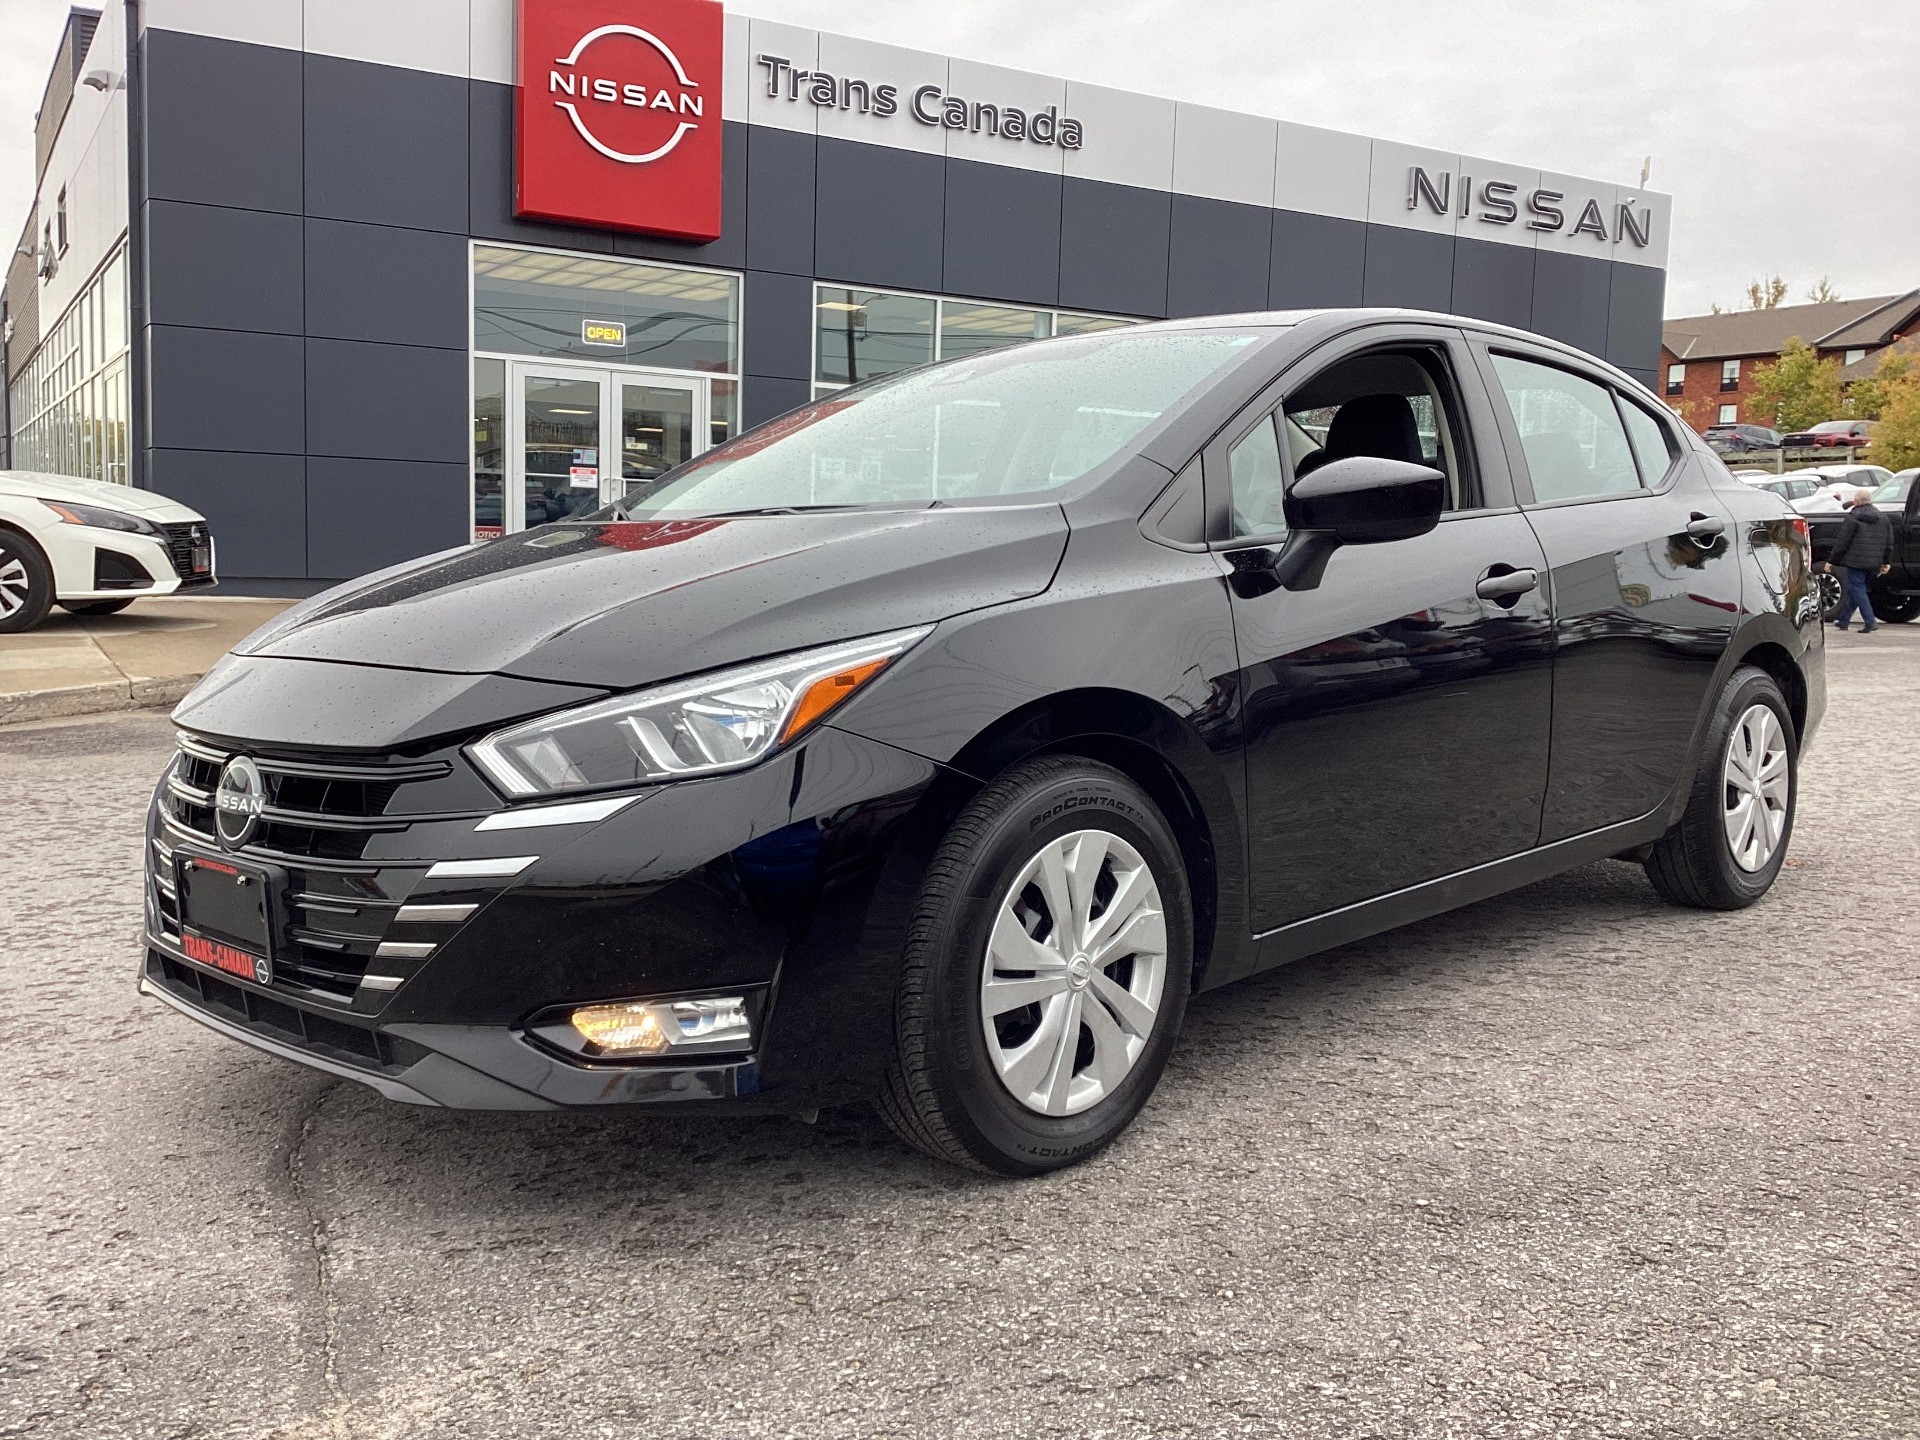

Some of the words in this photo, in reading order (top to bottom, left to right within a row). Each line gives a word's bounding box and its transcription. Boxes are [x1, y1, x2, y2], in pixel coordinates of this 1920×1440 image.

[549, 70, 703, 117] NISSAN
[758, 53, 898, 118] Trans
[909, 84, 1084, 150] Canada
[1408, 166, 1652, 248] NISSAN
[586, 326, 622, 341] OPEN
